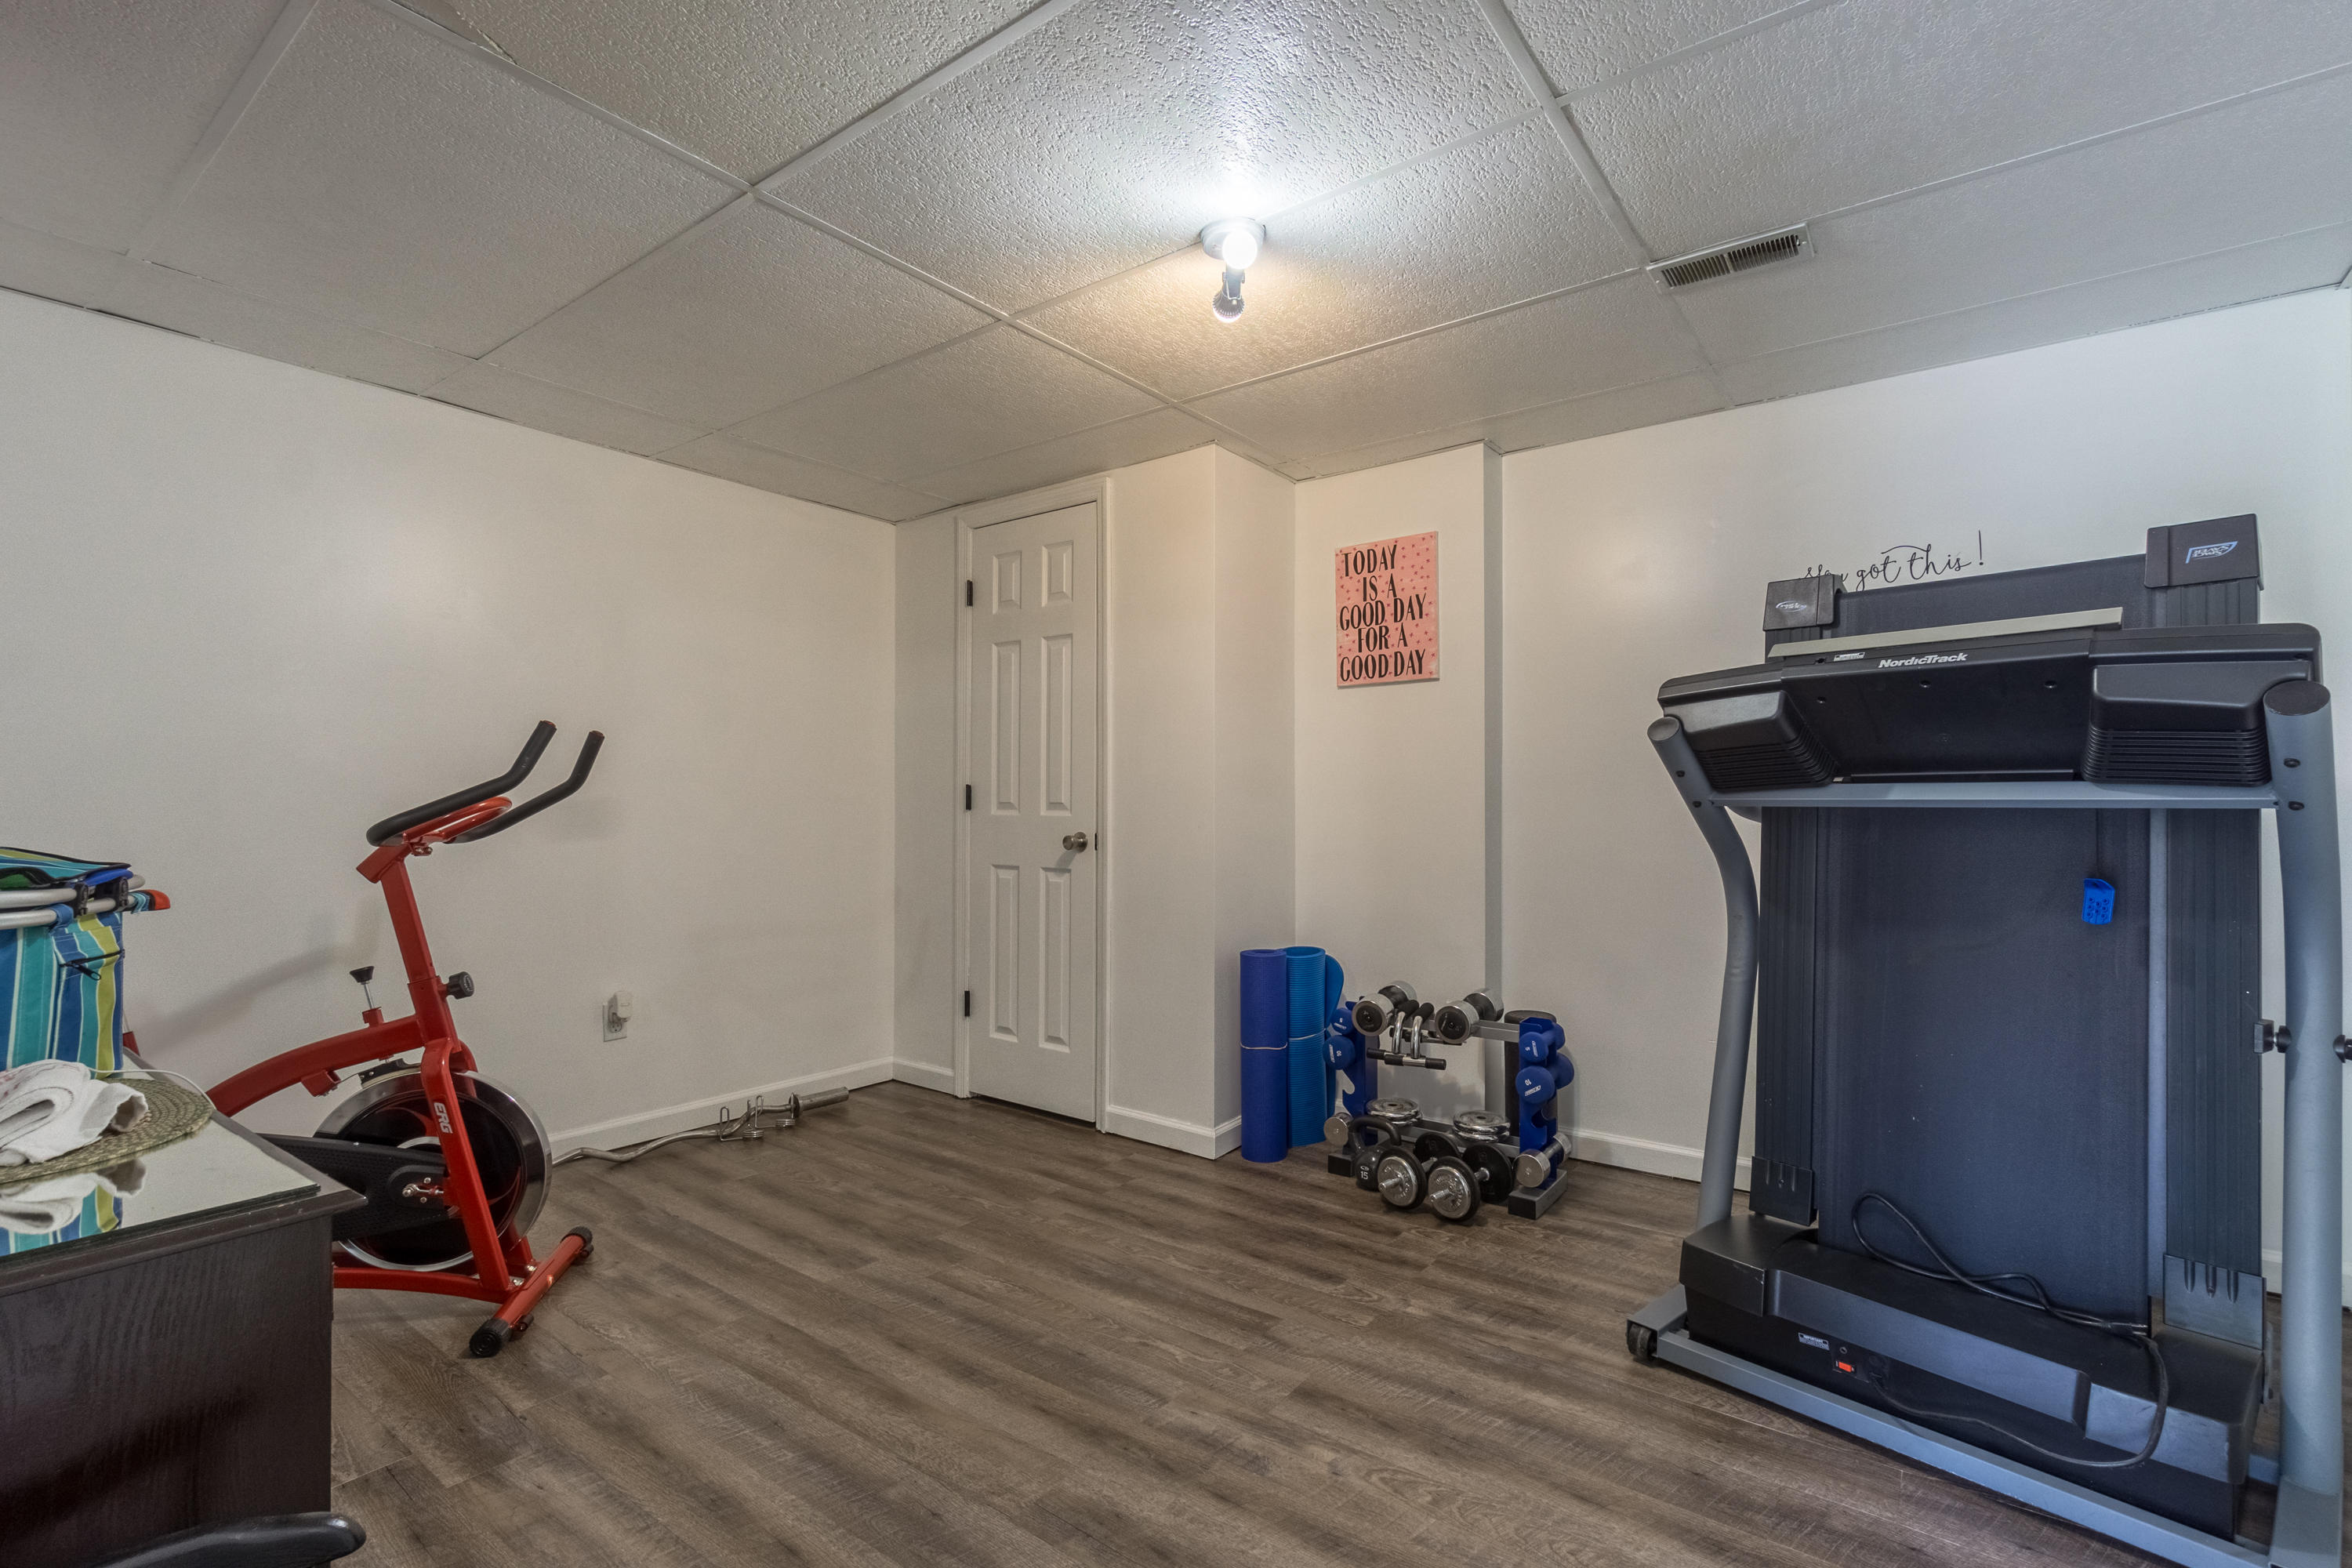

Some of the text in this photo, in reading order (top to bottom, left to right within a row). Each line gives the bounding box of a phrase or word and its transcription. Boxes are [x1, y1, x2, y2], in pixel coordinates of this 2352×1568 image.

[1341, 544, 1397, 577] TODAY
[1856, 556, 1901, 592] got
[1363, 572, 1397, 602] IS A
[1339, 592, 1427, 631] GOOD DAY
[1357, 622, 1408, 653] FOR A
[1340, 648, 1426, 682] GOOD DAY
[1878, 652, 1969, 668] NordicTrack
[434, 1102, 453, 1134] ERG
[1360, 1171, 1369, 1180] 15
